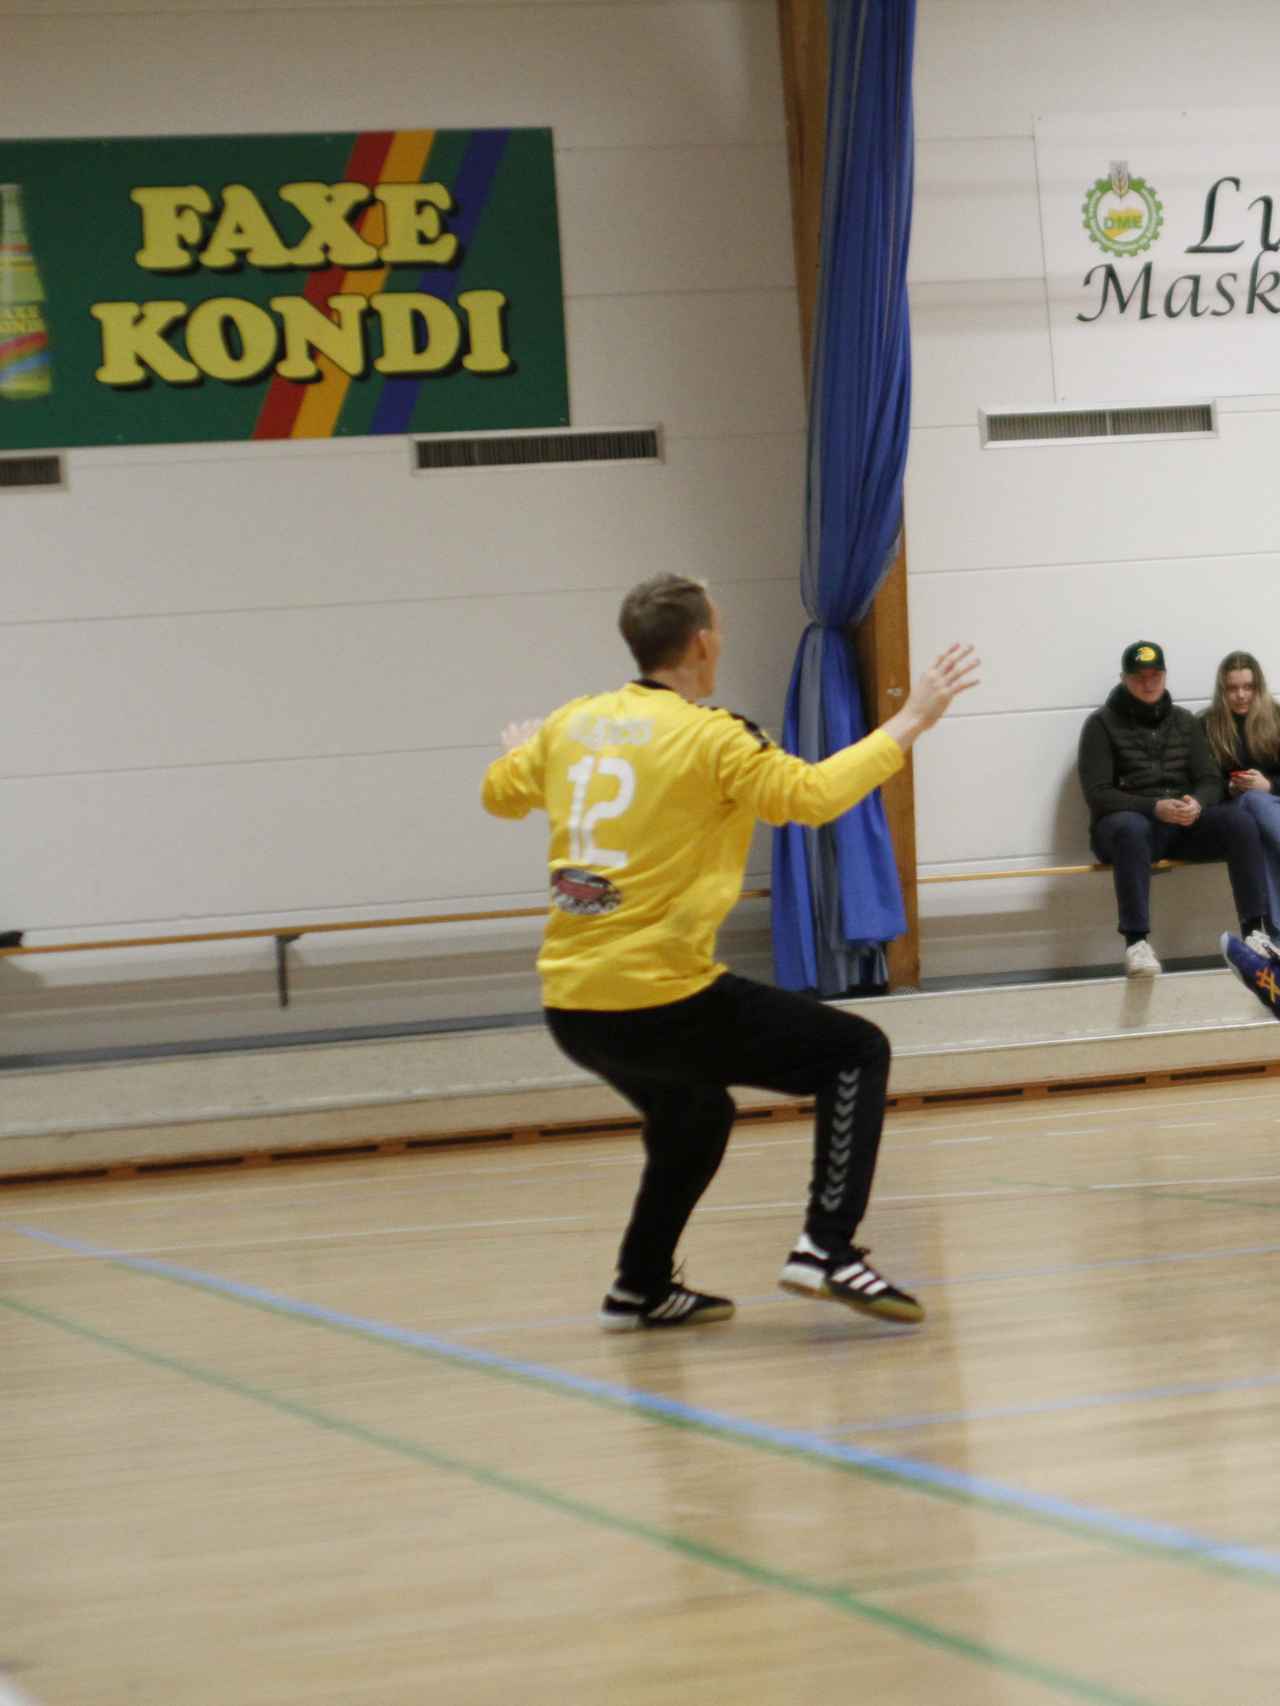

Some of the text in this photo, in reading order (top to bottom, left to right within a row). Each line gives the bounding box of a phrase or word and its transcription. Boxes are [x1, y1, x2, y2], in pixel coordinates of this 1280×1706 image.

[130, 181, 459, 270] FAXE
[90, 290, 512, 386] KONDI
[567, 754, 637, 869] 12
